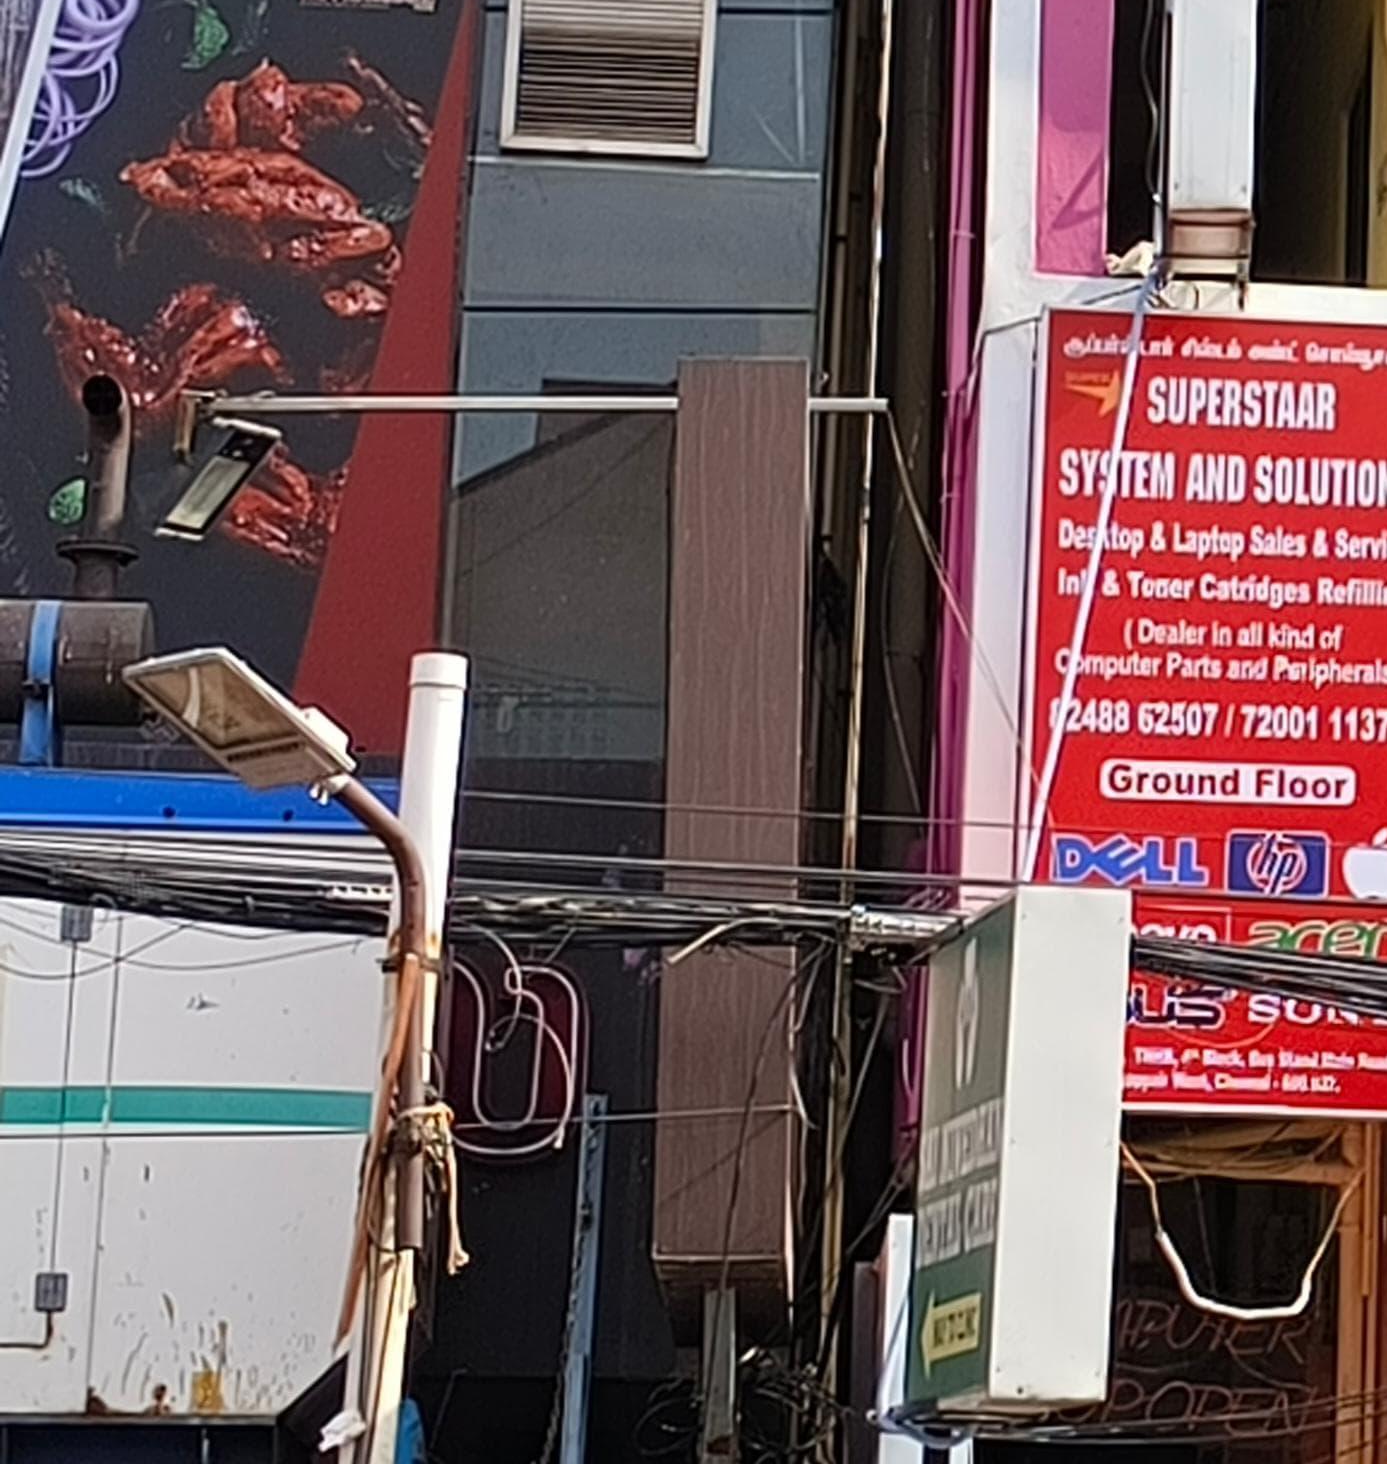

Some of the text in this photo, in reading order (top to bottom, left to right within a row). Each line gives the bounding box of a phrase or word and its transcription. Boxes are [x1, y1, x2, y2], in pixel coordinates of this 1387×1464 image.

[1147, 375, 1337, 431] SUPERSTAAR
[1058, 448, 1175, 500] SYSTEM
[1186, 454, 1247, 504] AND
[1173, 522, 1245, 562] Laptop
[1250, 525, 1306, 558] Sales
[1127, 570, 1193, 601] Toner
[1199, 572, 1311, 610] Catridges
[1137, 619, 1207, 646] Dealer
[1211, 621, 1232, 646] in
[1237, 622, 1263, 648] all
[1268, 623, 1315, 650] kind
[1319, 624, 1343, 651] of
[1055, 648, 1160, 681] Computer
[1166, 652, 1222, 680] Parts
[1226, 656, 1268, 681] and
[1138, 700, 1219, 736] 62507
[1240, 703, 1319, 739] 72001
[1107, 763, 1348, 800] Ground Floor
[1052, 832, 1210, 887] DELL
[1254, 833, 1303, 895] hp
